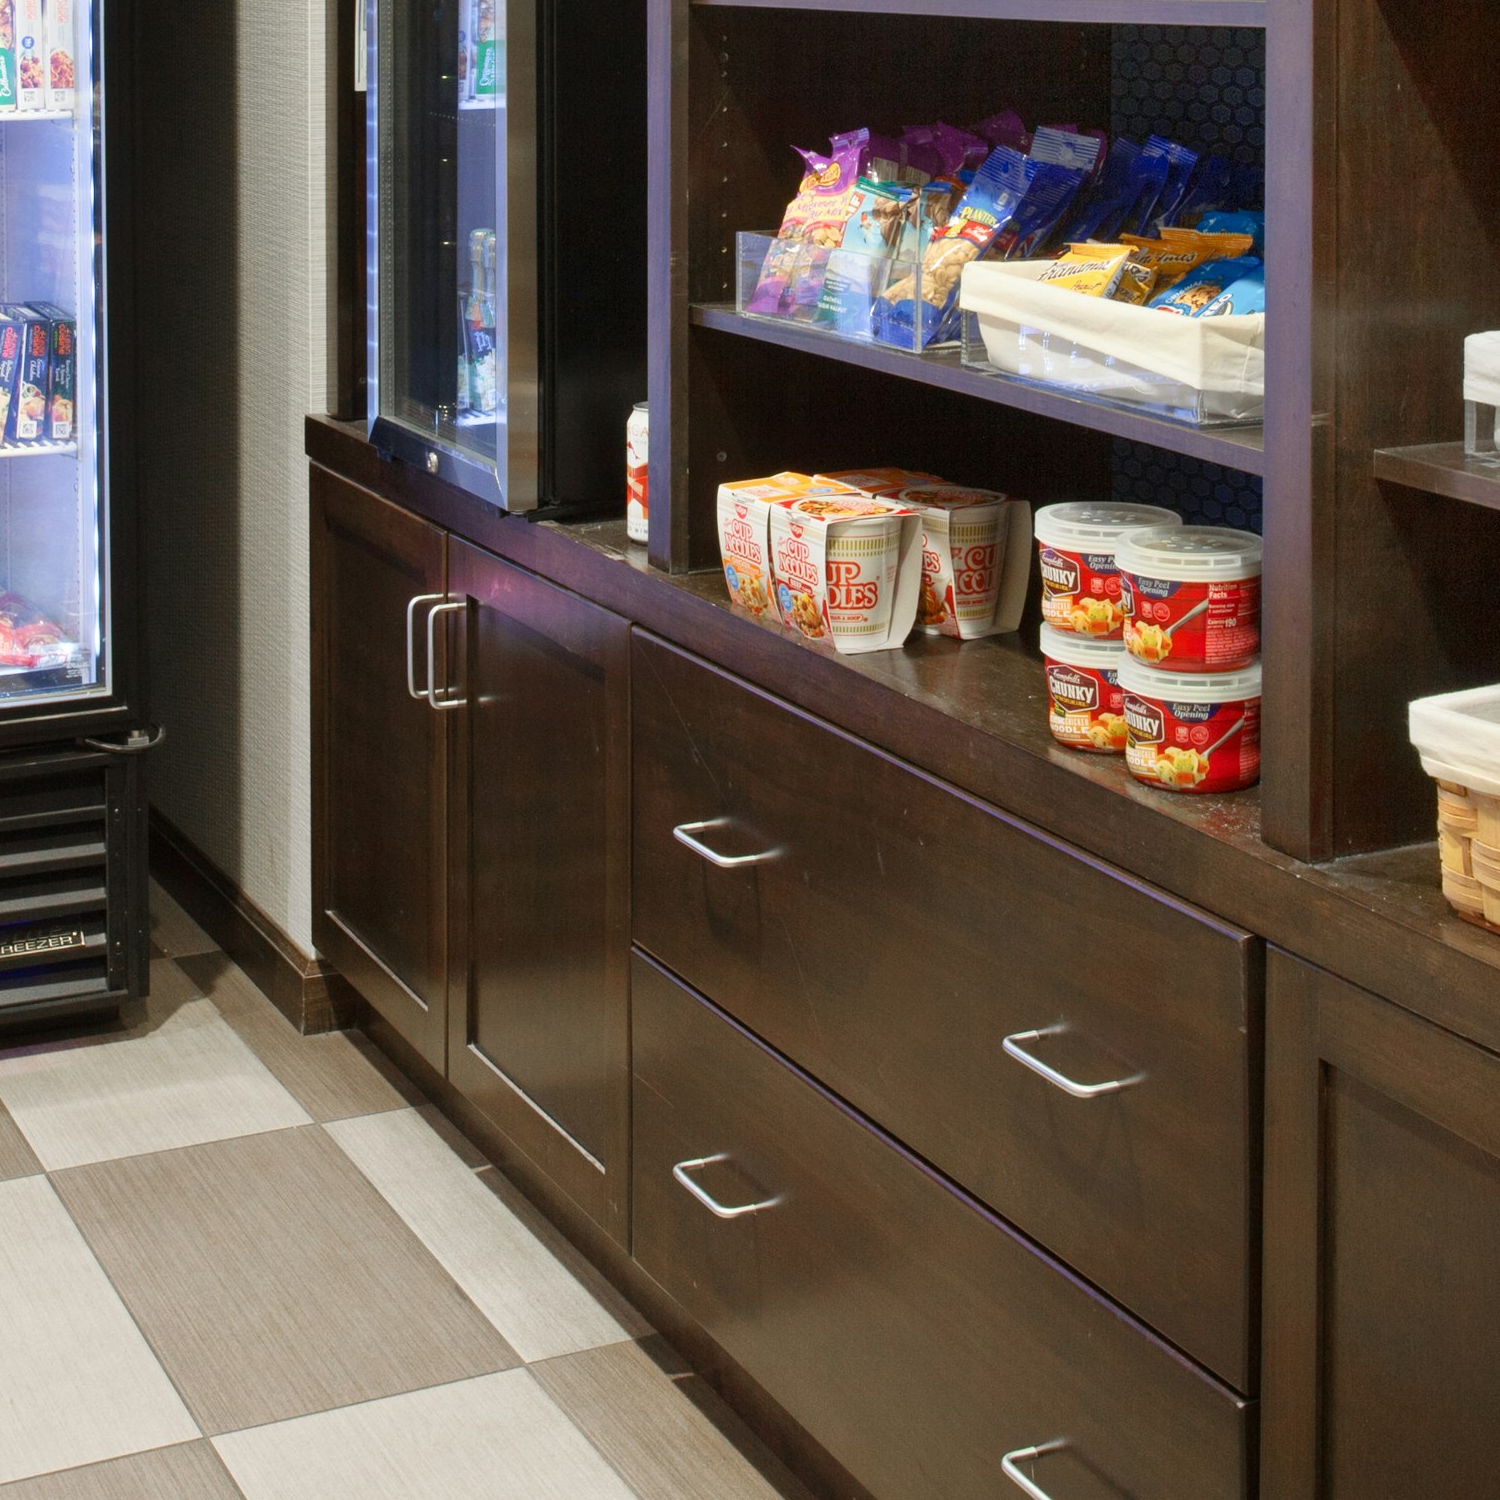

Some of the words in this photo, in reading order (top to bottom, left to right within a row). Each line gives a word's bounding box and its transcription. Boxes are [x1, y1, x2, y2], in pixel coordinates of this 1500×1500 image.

[731, 518, 753, 540] CUP
[724, 531, 762, 565] NOODLES
[785, 537, 811, 560] CUP
[778, 549, 819, 586] NOODLES
[1139, 585, 1169, 598] Opening
[1154, 579, 1171, 590] Peel
[1209, 591, 1228, 599] Facts
[1049, 674, 1094, 703] CHUNKY
[1174, 709, 1210, 721] Opening
[1193, 703, 1211, 713] Peel
